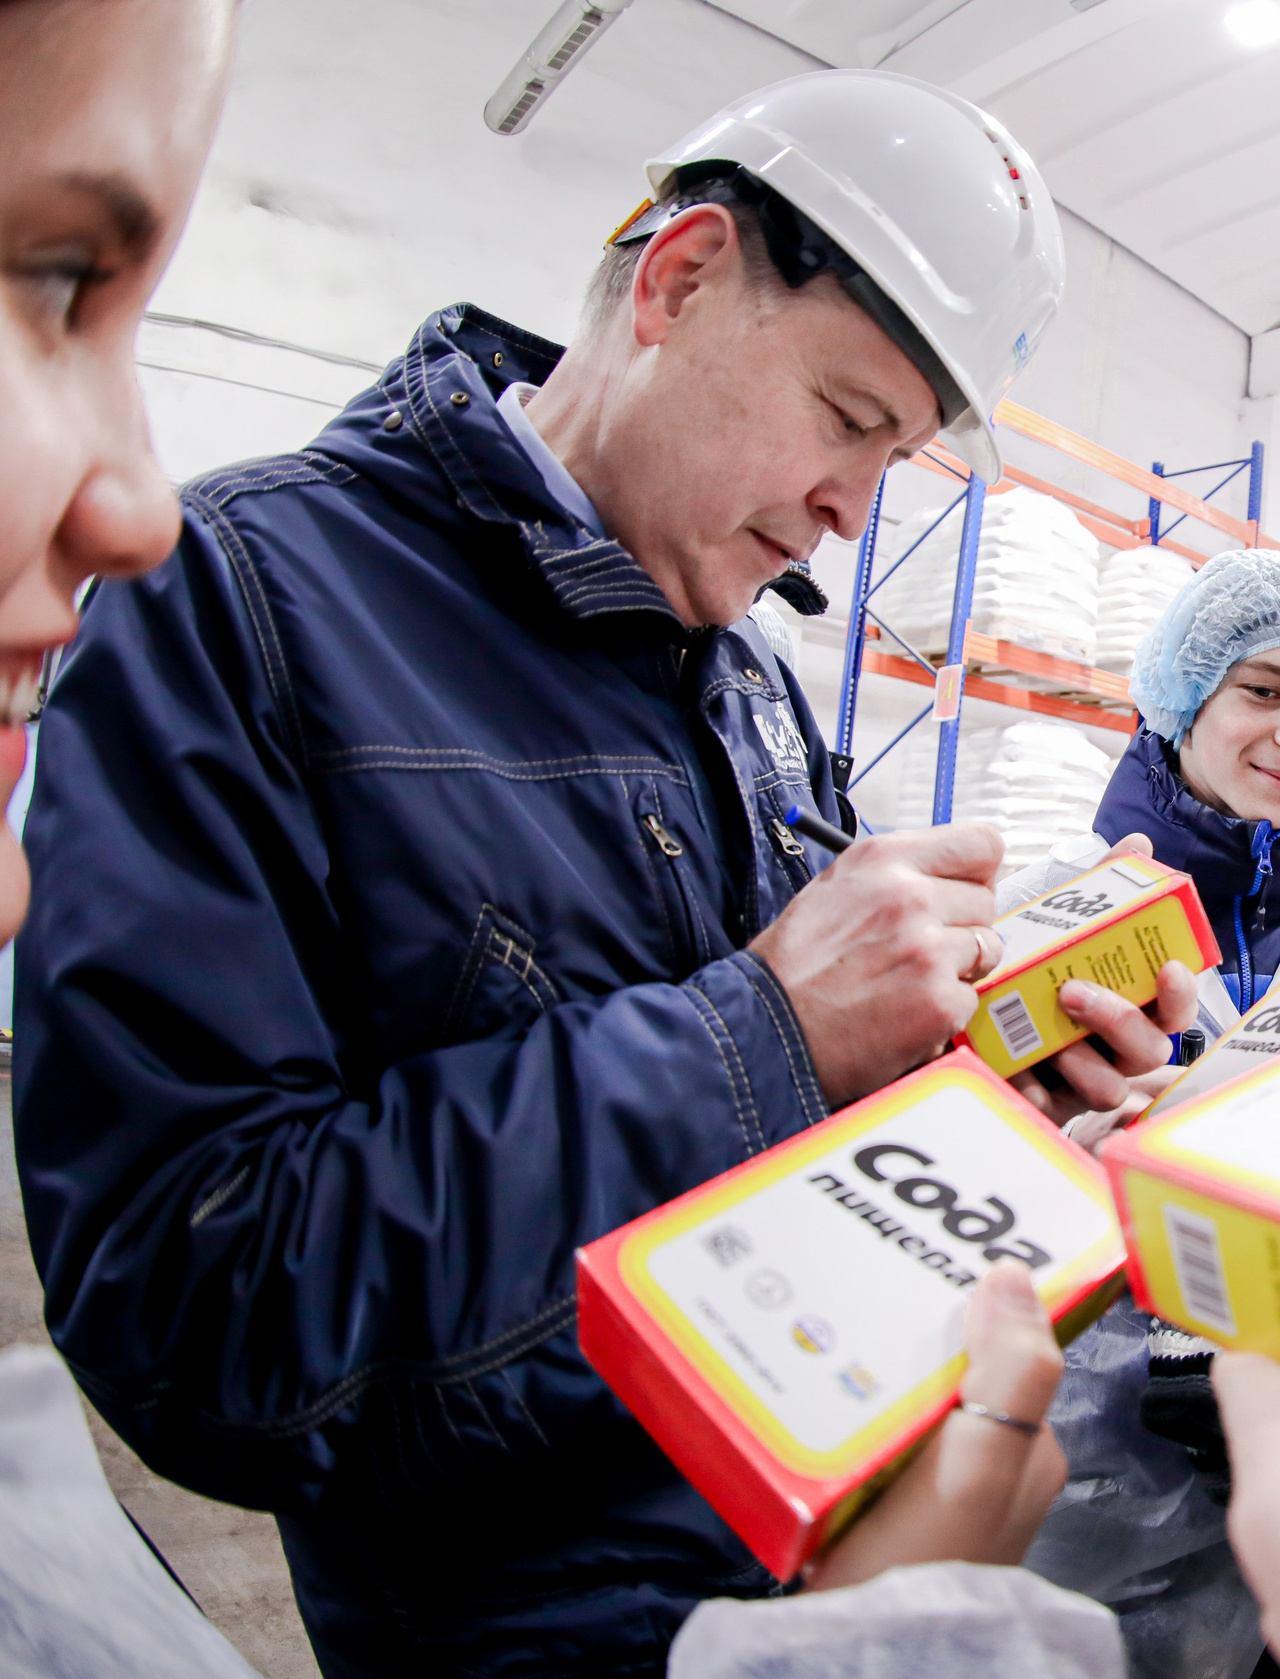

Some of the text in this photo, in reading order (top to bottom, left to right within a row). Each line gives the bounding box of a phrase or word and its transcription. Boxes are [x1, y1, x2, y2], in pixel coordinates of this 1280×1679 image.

[1041, 889, 1114, 918] Сода
[810, 1174, 977, 1287] пищева
[854, 1143, 1052, 1270] Сода
